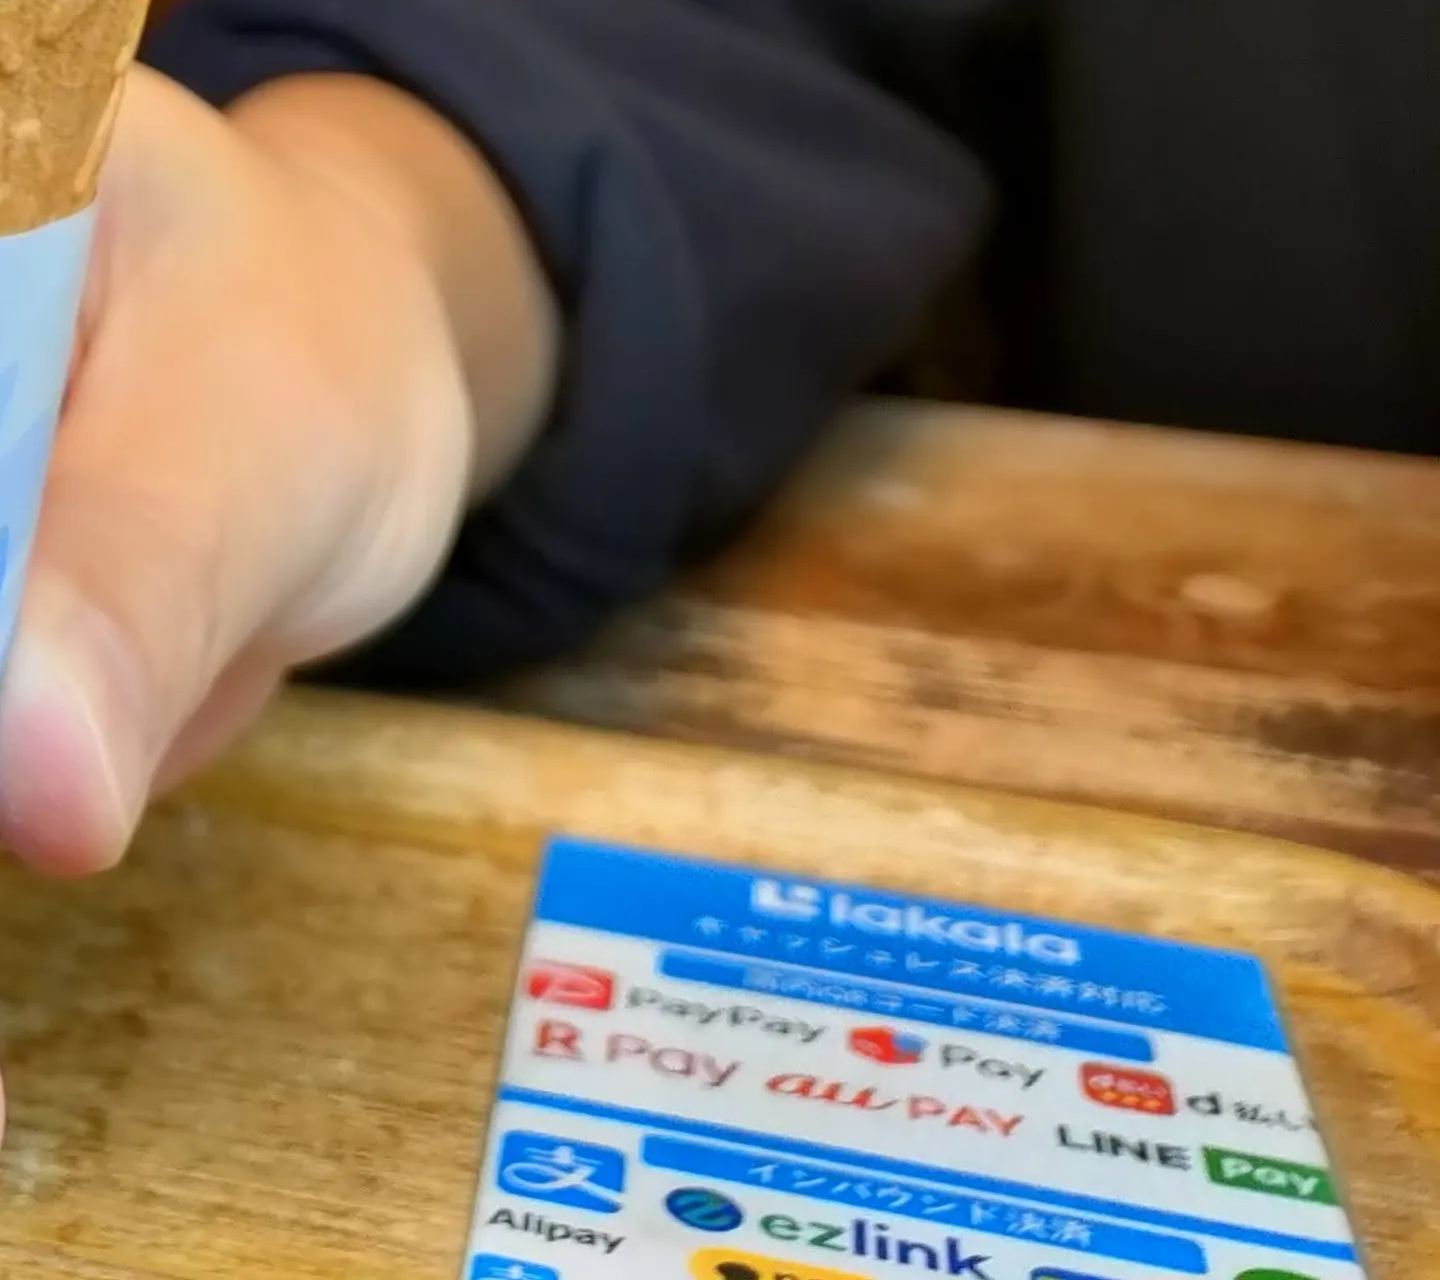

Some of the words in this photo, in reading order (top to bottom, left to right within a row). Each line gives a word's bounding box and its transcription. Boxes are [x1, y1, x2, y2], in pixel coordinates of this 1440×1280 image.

[828, 893, 1083, 966] lakala
[626, 984, 828, 1043] PayPay
[606, 1032, 743, 1090] Pay
[939, 1043, 1046, 1090] Pay
[764, 1072, 900, 1111] au
[906, 1094, 1024, 1140] PAY
[1055, 1124, 1193, 1172] LINE
[488, 1207, 627, 1255] Alipay
[748, 1161, 1094, 1248] インバウンド決済
[759, 1212, 993, 1279] ezlink
